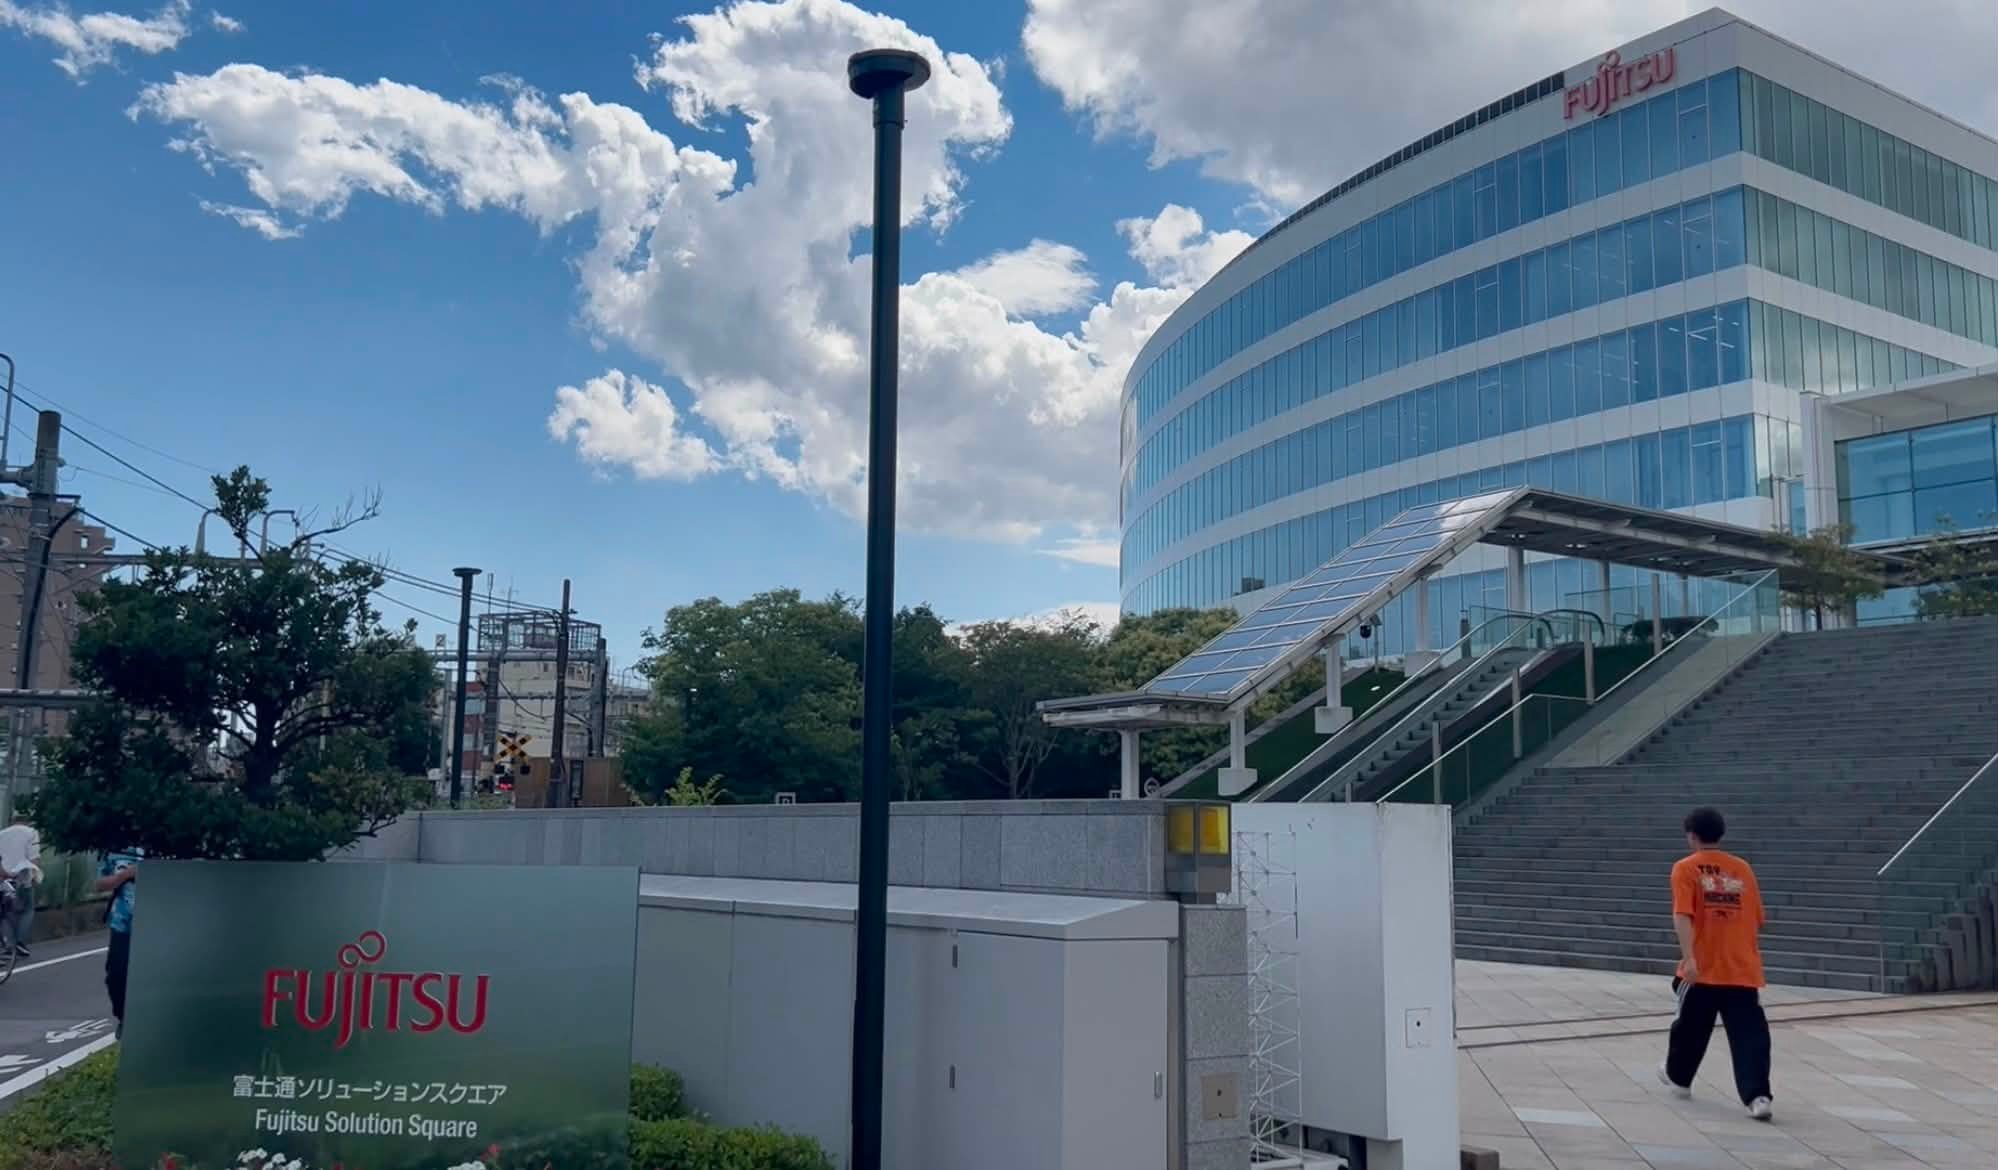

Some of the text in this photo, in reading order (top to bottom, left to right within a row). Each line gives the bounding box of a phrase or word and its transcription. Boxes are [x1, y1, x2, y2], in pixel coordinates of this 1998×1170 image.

[1563, 49, 1676, 119] FUJITSU
[262, 930, 491, 1048] FUJITSU
[232, 1074, 508, 1105] 富士通ソリューションスクエア
[255, 1107, 478, 1141] Fujitsu Solution Square
